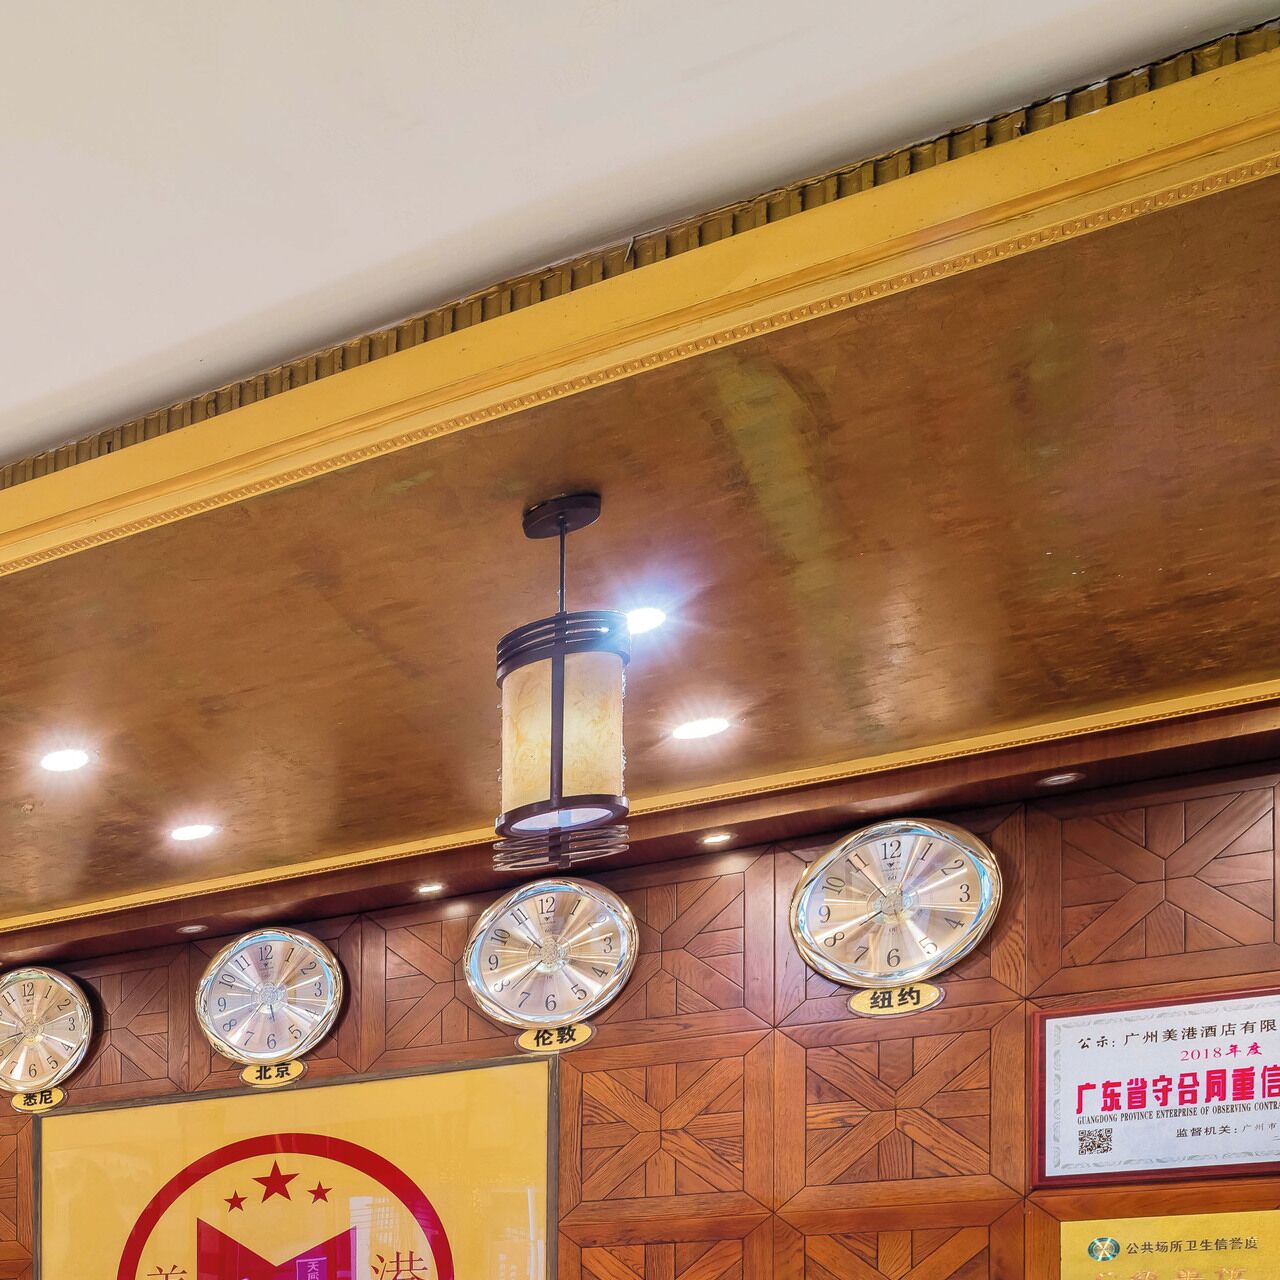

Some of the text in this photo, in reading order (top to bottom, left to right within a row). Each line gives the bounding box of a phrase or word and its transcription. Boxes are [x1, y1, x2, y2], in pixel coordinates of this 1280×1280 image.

[870, 988, 920, 1009] 纽约
[534, 1025, 576, 1047] 伦敦
[1181, 1042, 1263, 1061] 2018年度
[256, 1063, 290, 1080] 北京
[23, 1091, 53, 1106] 悉尼
[1077, 1114, 1118, 1125] GUANGDONG
[1120, 1110, 1153, 1122] PROVINCE
[1156, 1107, 1198, 1119] ENTERPRISE
[1200, 1106, 1209, 1116] OF
[1212, 1103, 1251, 1115] OBSERVING
[1126, 1236, 1258, 1255] 公共场所卫生信誉度
